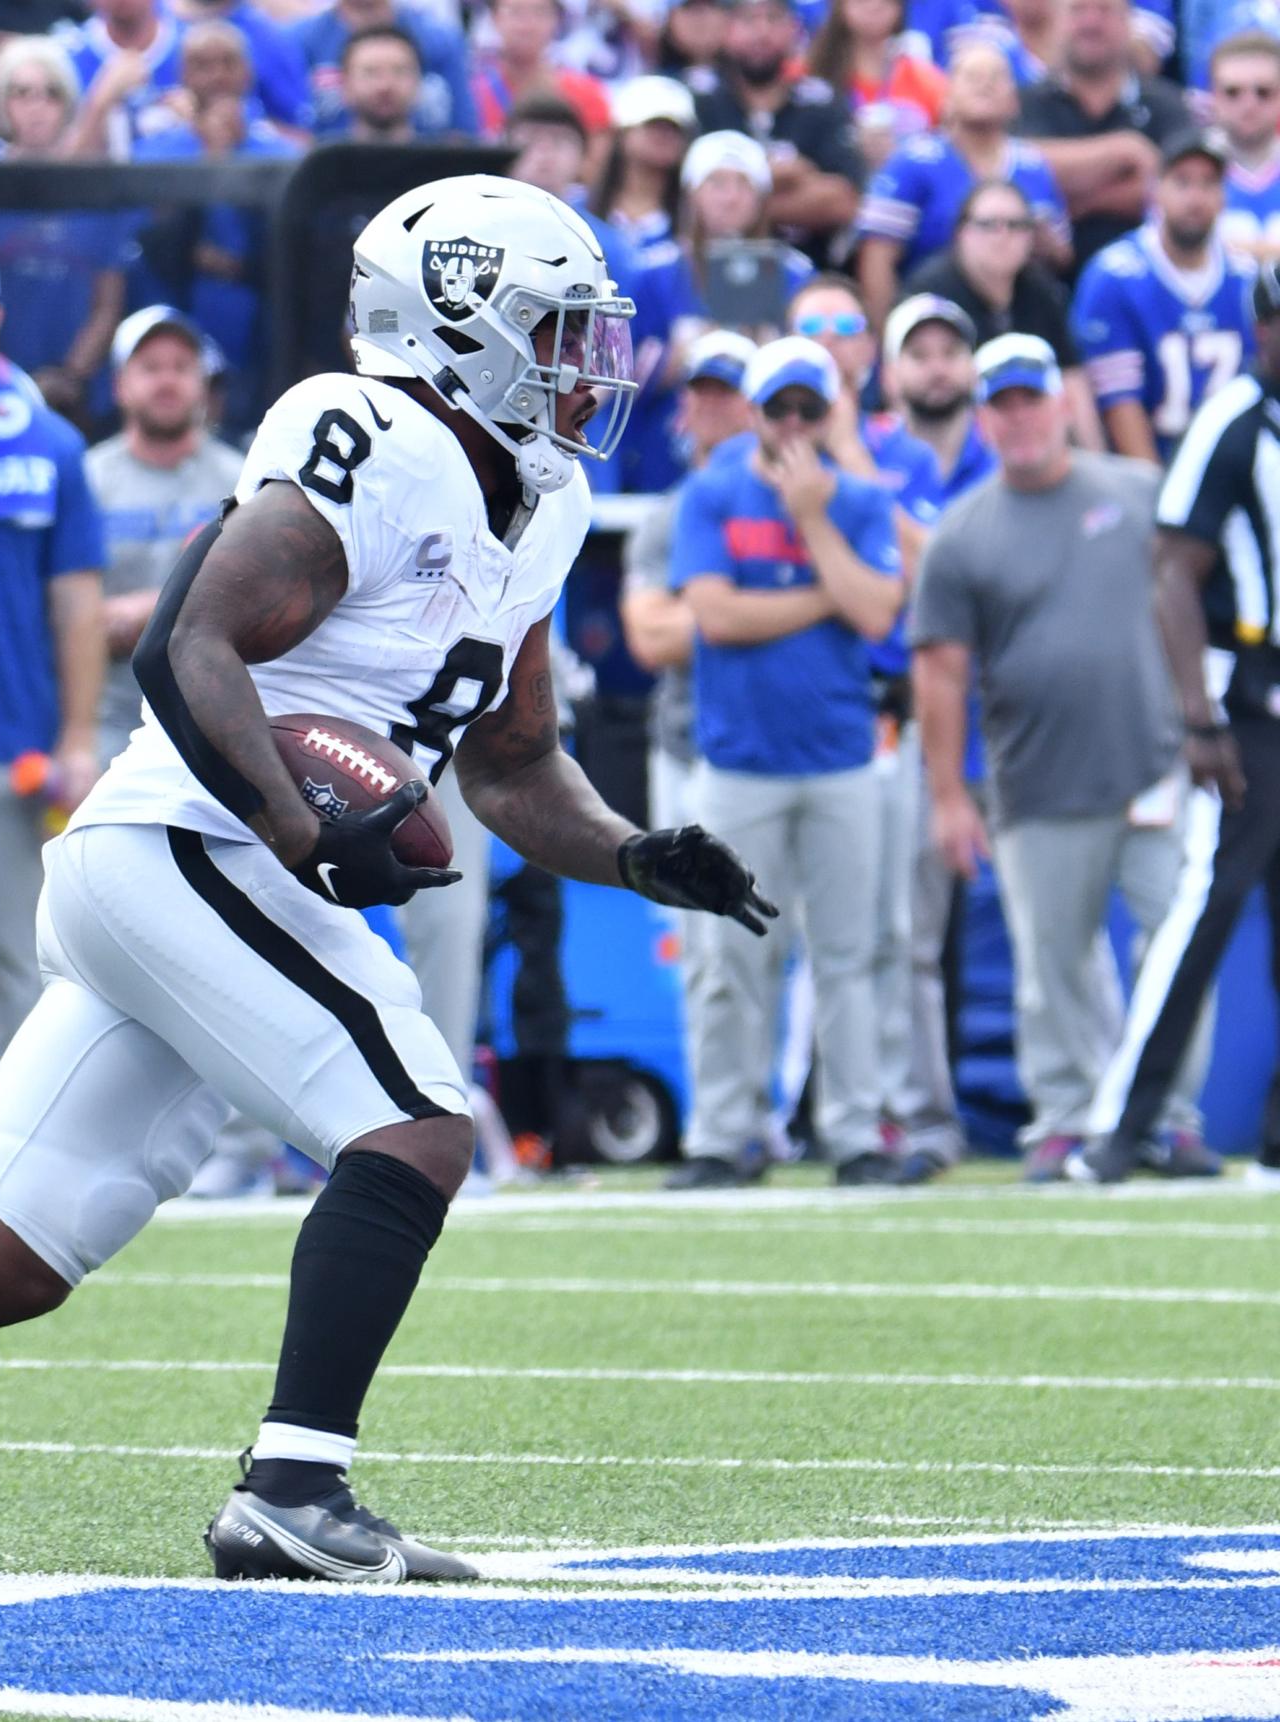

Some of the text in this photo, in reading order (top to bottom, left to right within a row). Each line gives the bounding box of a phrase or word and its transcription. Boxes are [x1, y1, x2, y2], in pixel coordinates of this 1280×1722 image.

[429, 242, 498, 259] RAIDERS
[1153, 330, 1242, 433] 17
[298, 408, 373, 506] 8
[415, 532, 453, 569] C
[389, 634, 504, 788] 8
